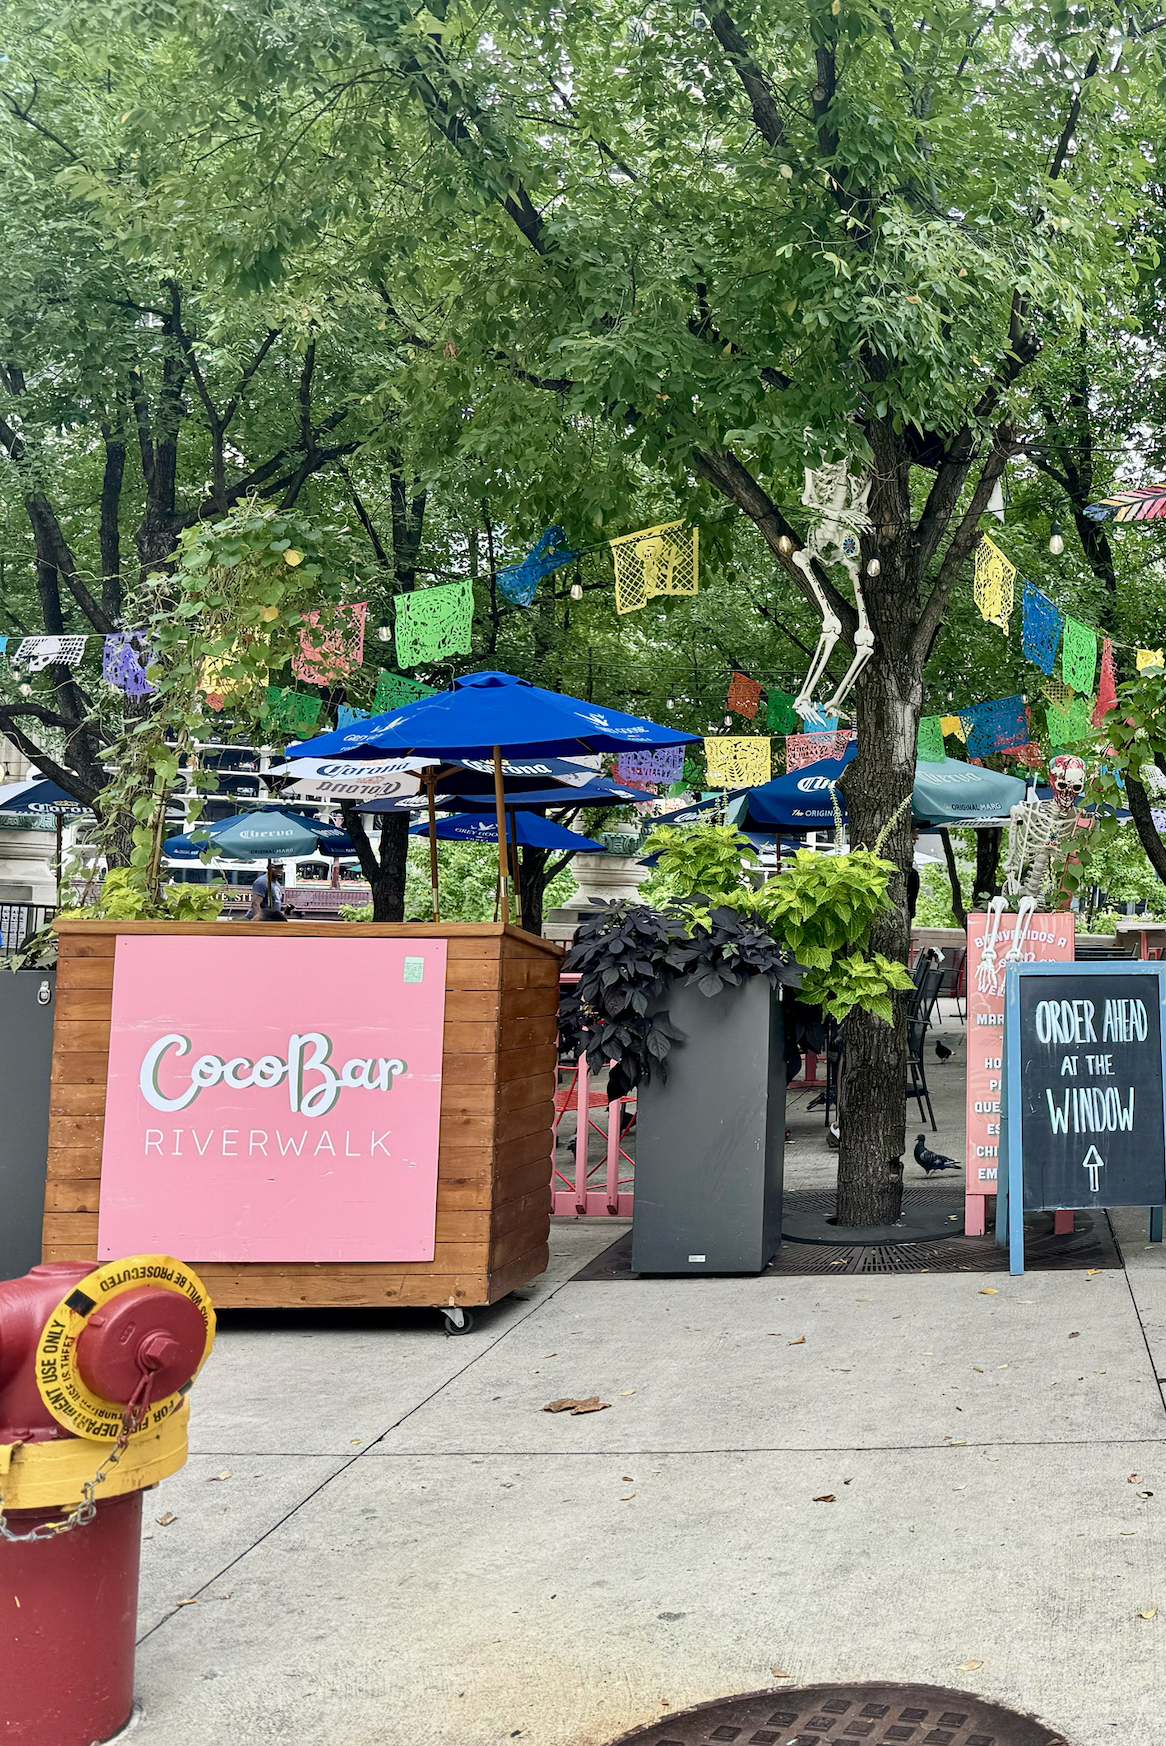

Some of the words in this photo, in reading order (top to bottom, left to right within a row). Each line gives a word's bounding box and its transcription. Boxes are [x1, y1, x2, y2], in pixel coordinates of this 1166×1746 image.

[316, 762, 411, 778] Corona
[239, 829, 294, 839] Cuervo
[1057, 937, 1067, 948] A
[1035, 1000, 1098, 1043] ORDER
[1102, 999, 1148, 1042] AHEAD
[139, 1033, 407, 1117] CocoBar
[1060, 1055, 1079, 1076] AT
[1085, 1054, 1116, 1075] THE
[1046, 1086, 1135, 1134] WINDOW
[145, 1129, 391, 1157] RIVERWALK
[99, 1265, 173, 1292] PROSECUTED
[173, 1272, 188, 1287] BE
[43, 1319, 67, 1353] ONLY
[41, 1359, 58, 1384] USE
